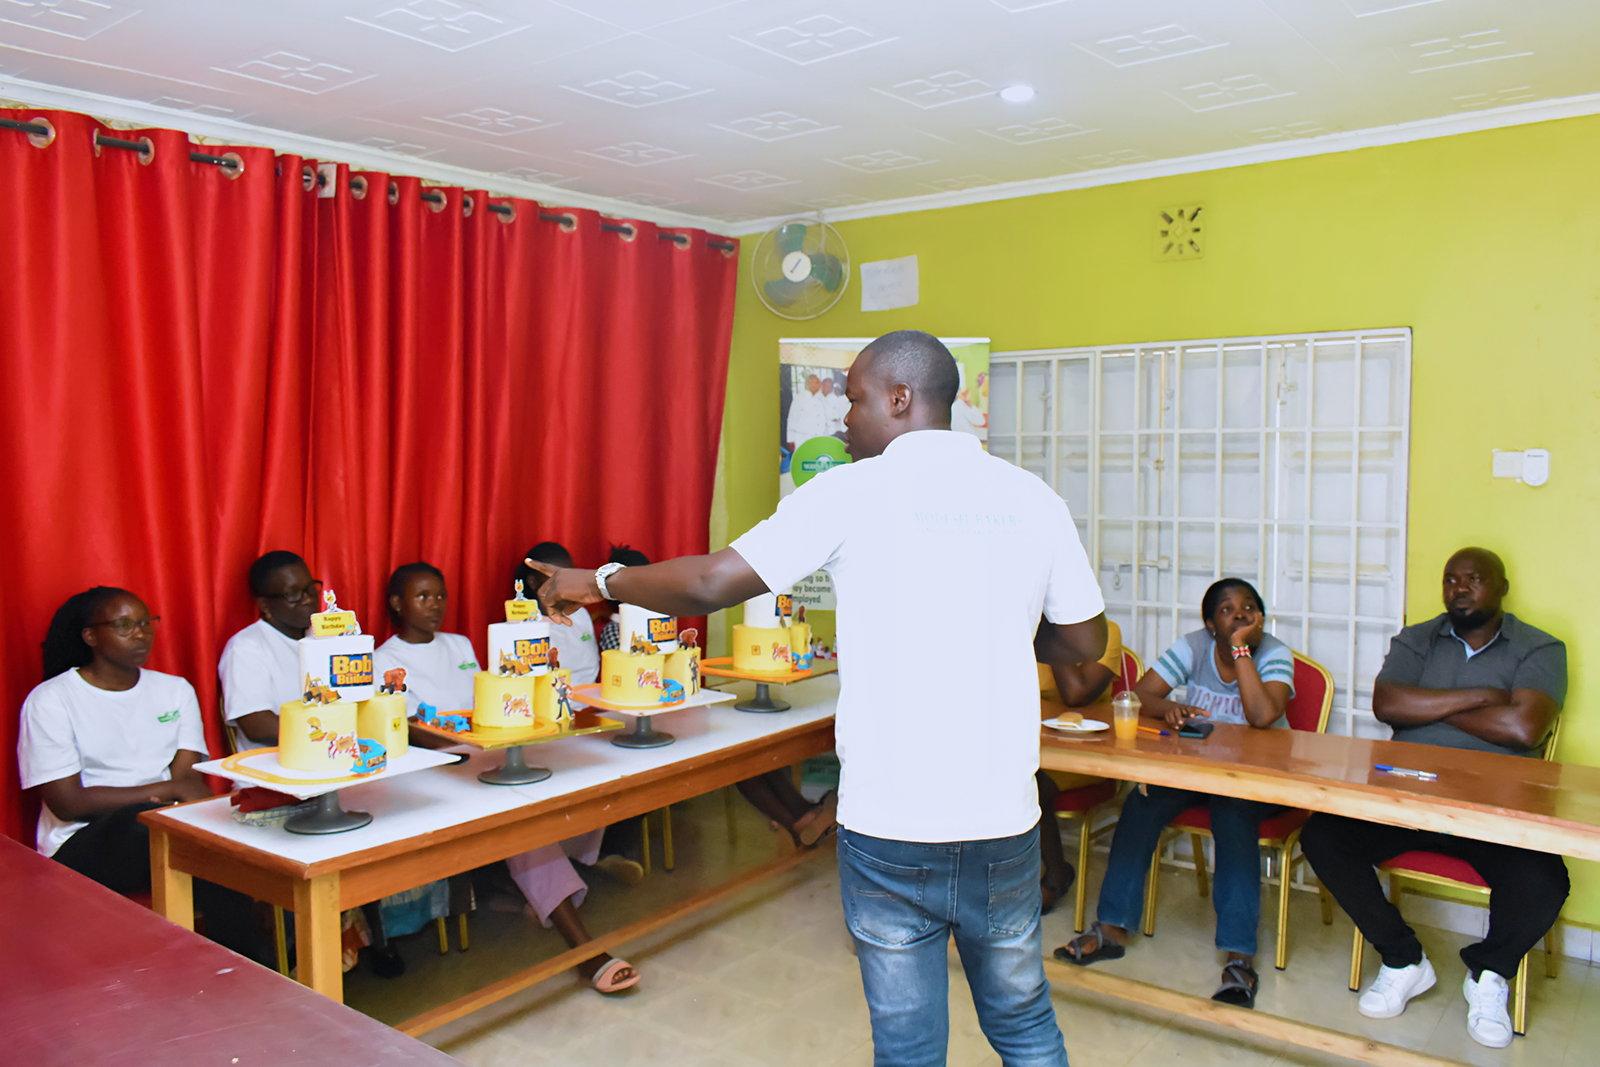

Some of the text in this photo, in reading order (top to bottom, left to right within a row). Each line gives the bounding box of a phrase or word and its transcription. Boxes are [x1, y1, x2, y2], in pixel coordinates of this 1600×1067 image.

[804, 584, 831, 592] become
[778, 595, 793, 608] Bo
[516, 639, 549, 657] Bob
[332, 655, 372, 675] Bob
